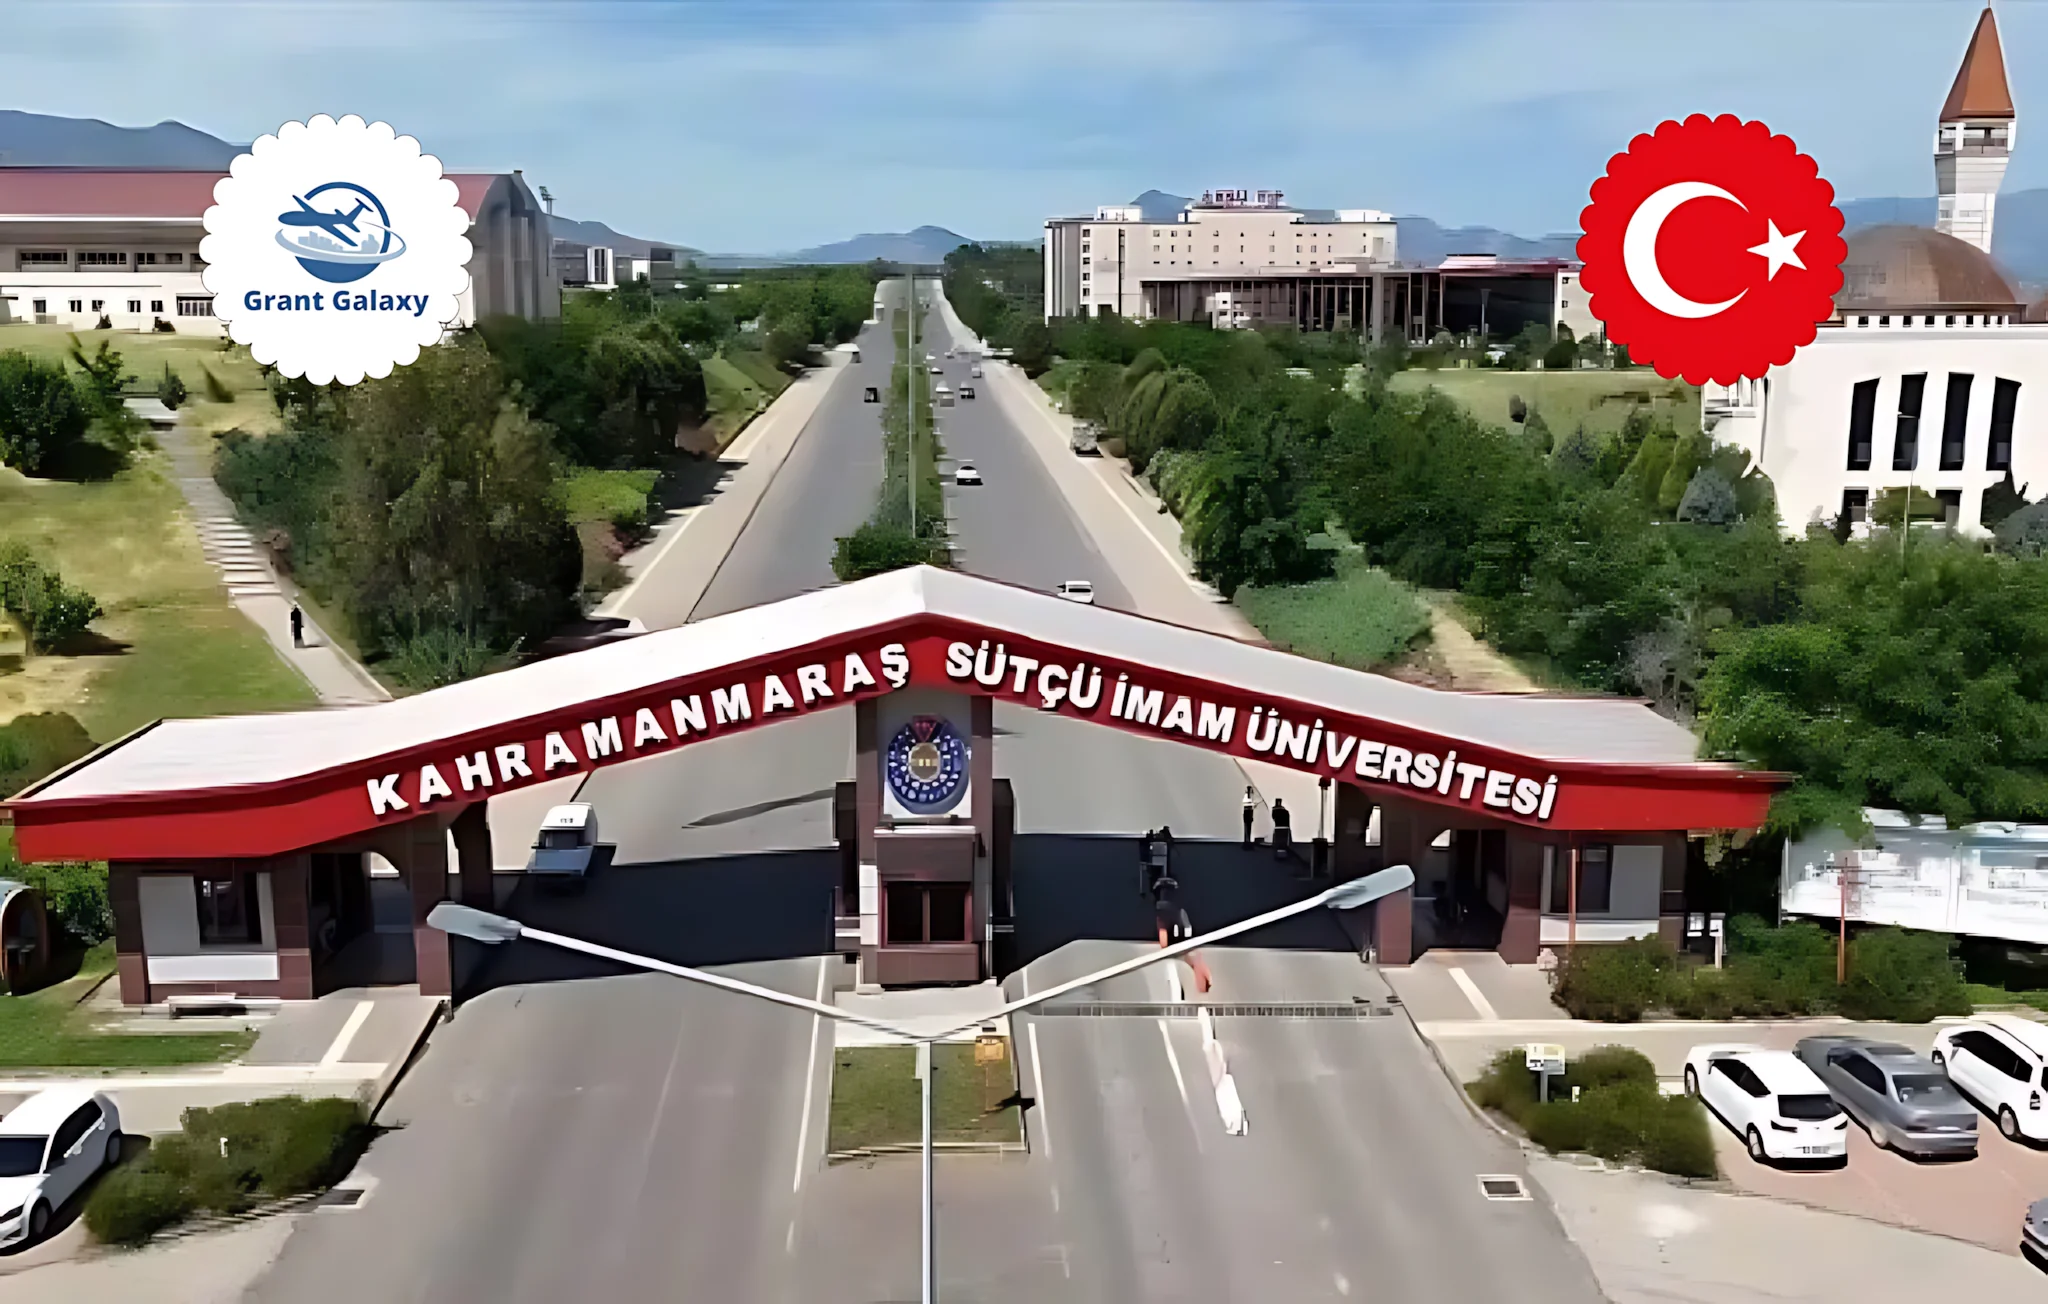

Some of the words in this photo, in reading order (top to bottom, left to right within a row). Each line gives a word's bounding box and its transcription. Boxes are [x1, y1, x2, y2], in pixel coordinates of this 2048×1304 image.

[367, 643, 910, 815] KAHRAMANMARAŞ
[946, 639, 1102, 709] SÜTÇÜ
[1110, 672, 1237, 743] İMAM
[1246, 706, 1559, 820] ÜNİVERSİTESİ
